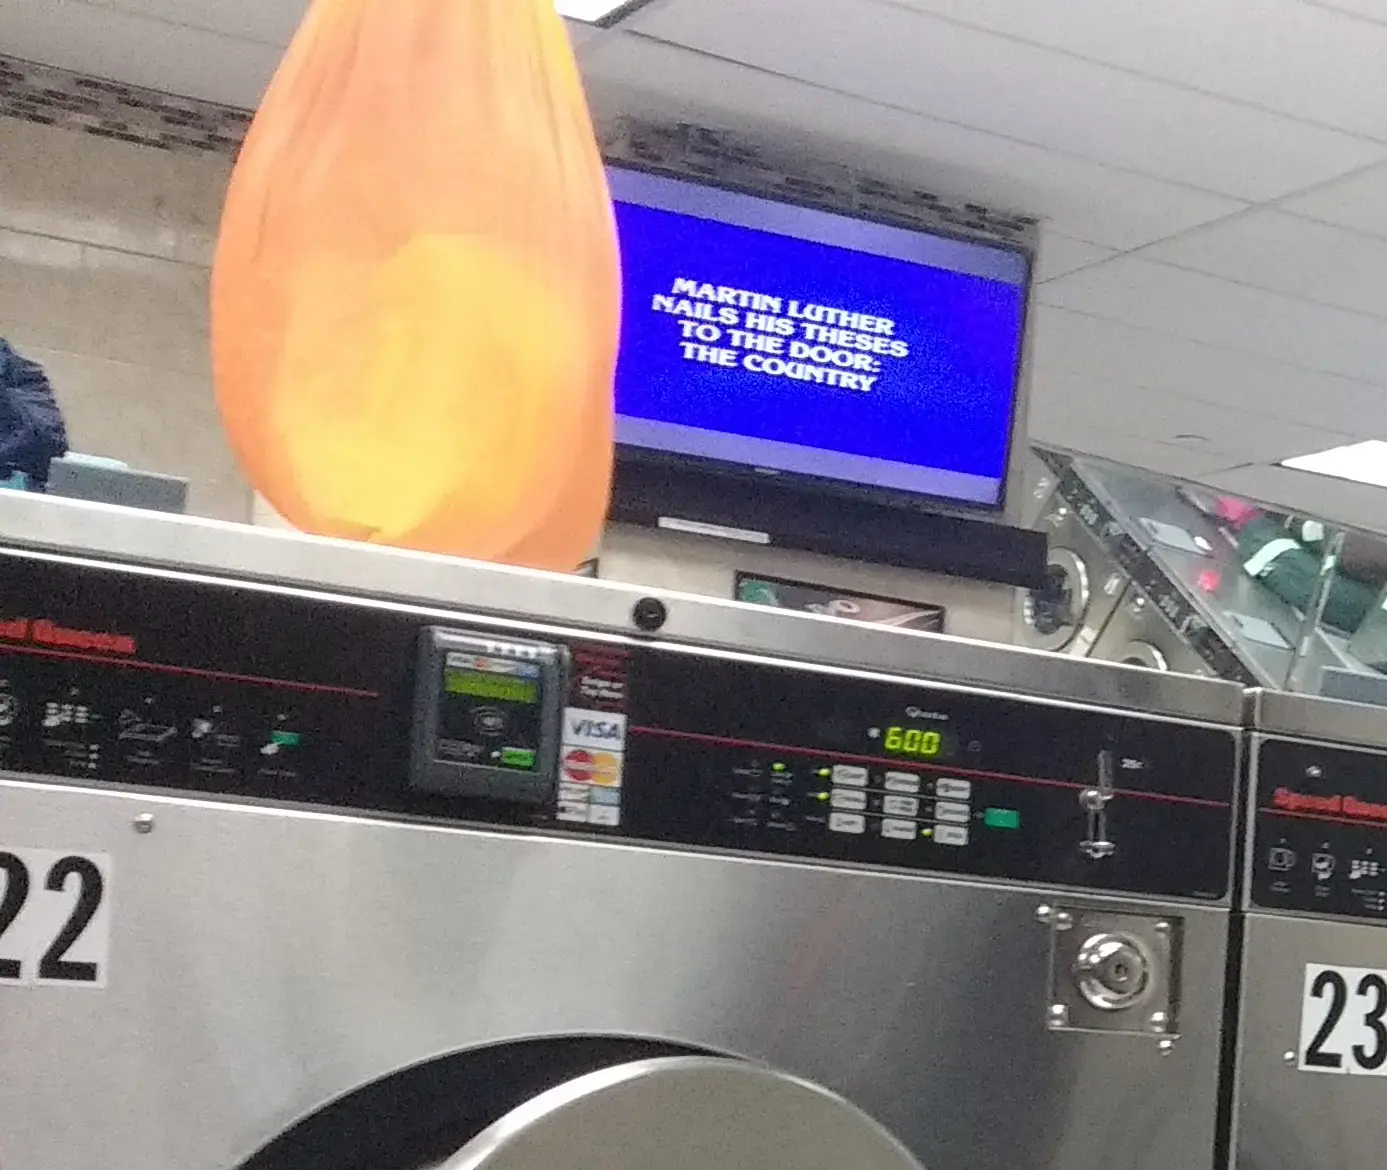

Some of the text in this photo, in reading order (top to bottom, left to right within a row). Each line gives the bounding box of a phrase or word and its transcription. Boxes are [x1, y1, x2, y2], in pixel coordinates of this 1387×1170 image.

[651, 294, 909, 357] NAILS HIS THESES
[672, 277, 895, 336] MARTIN LUTHER
[678, 319, 882, 373] TO THE DOOR:
[679, 341, 878, 392] THE COUNTRY
[571, 718, 621, 739] VISA
[885, 726, 941, 755] 600
[0, 851, 103, 981] 22
